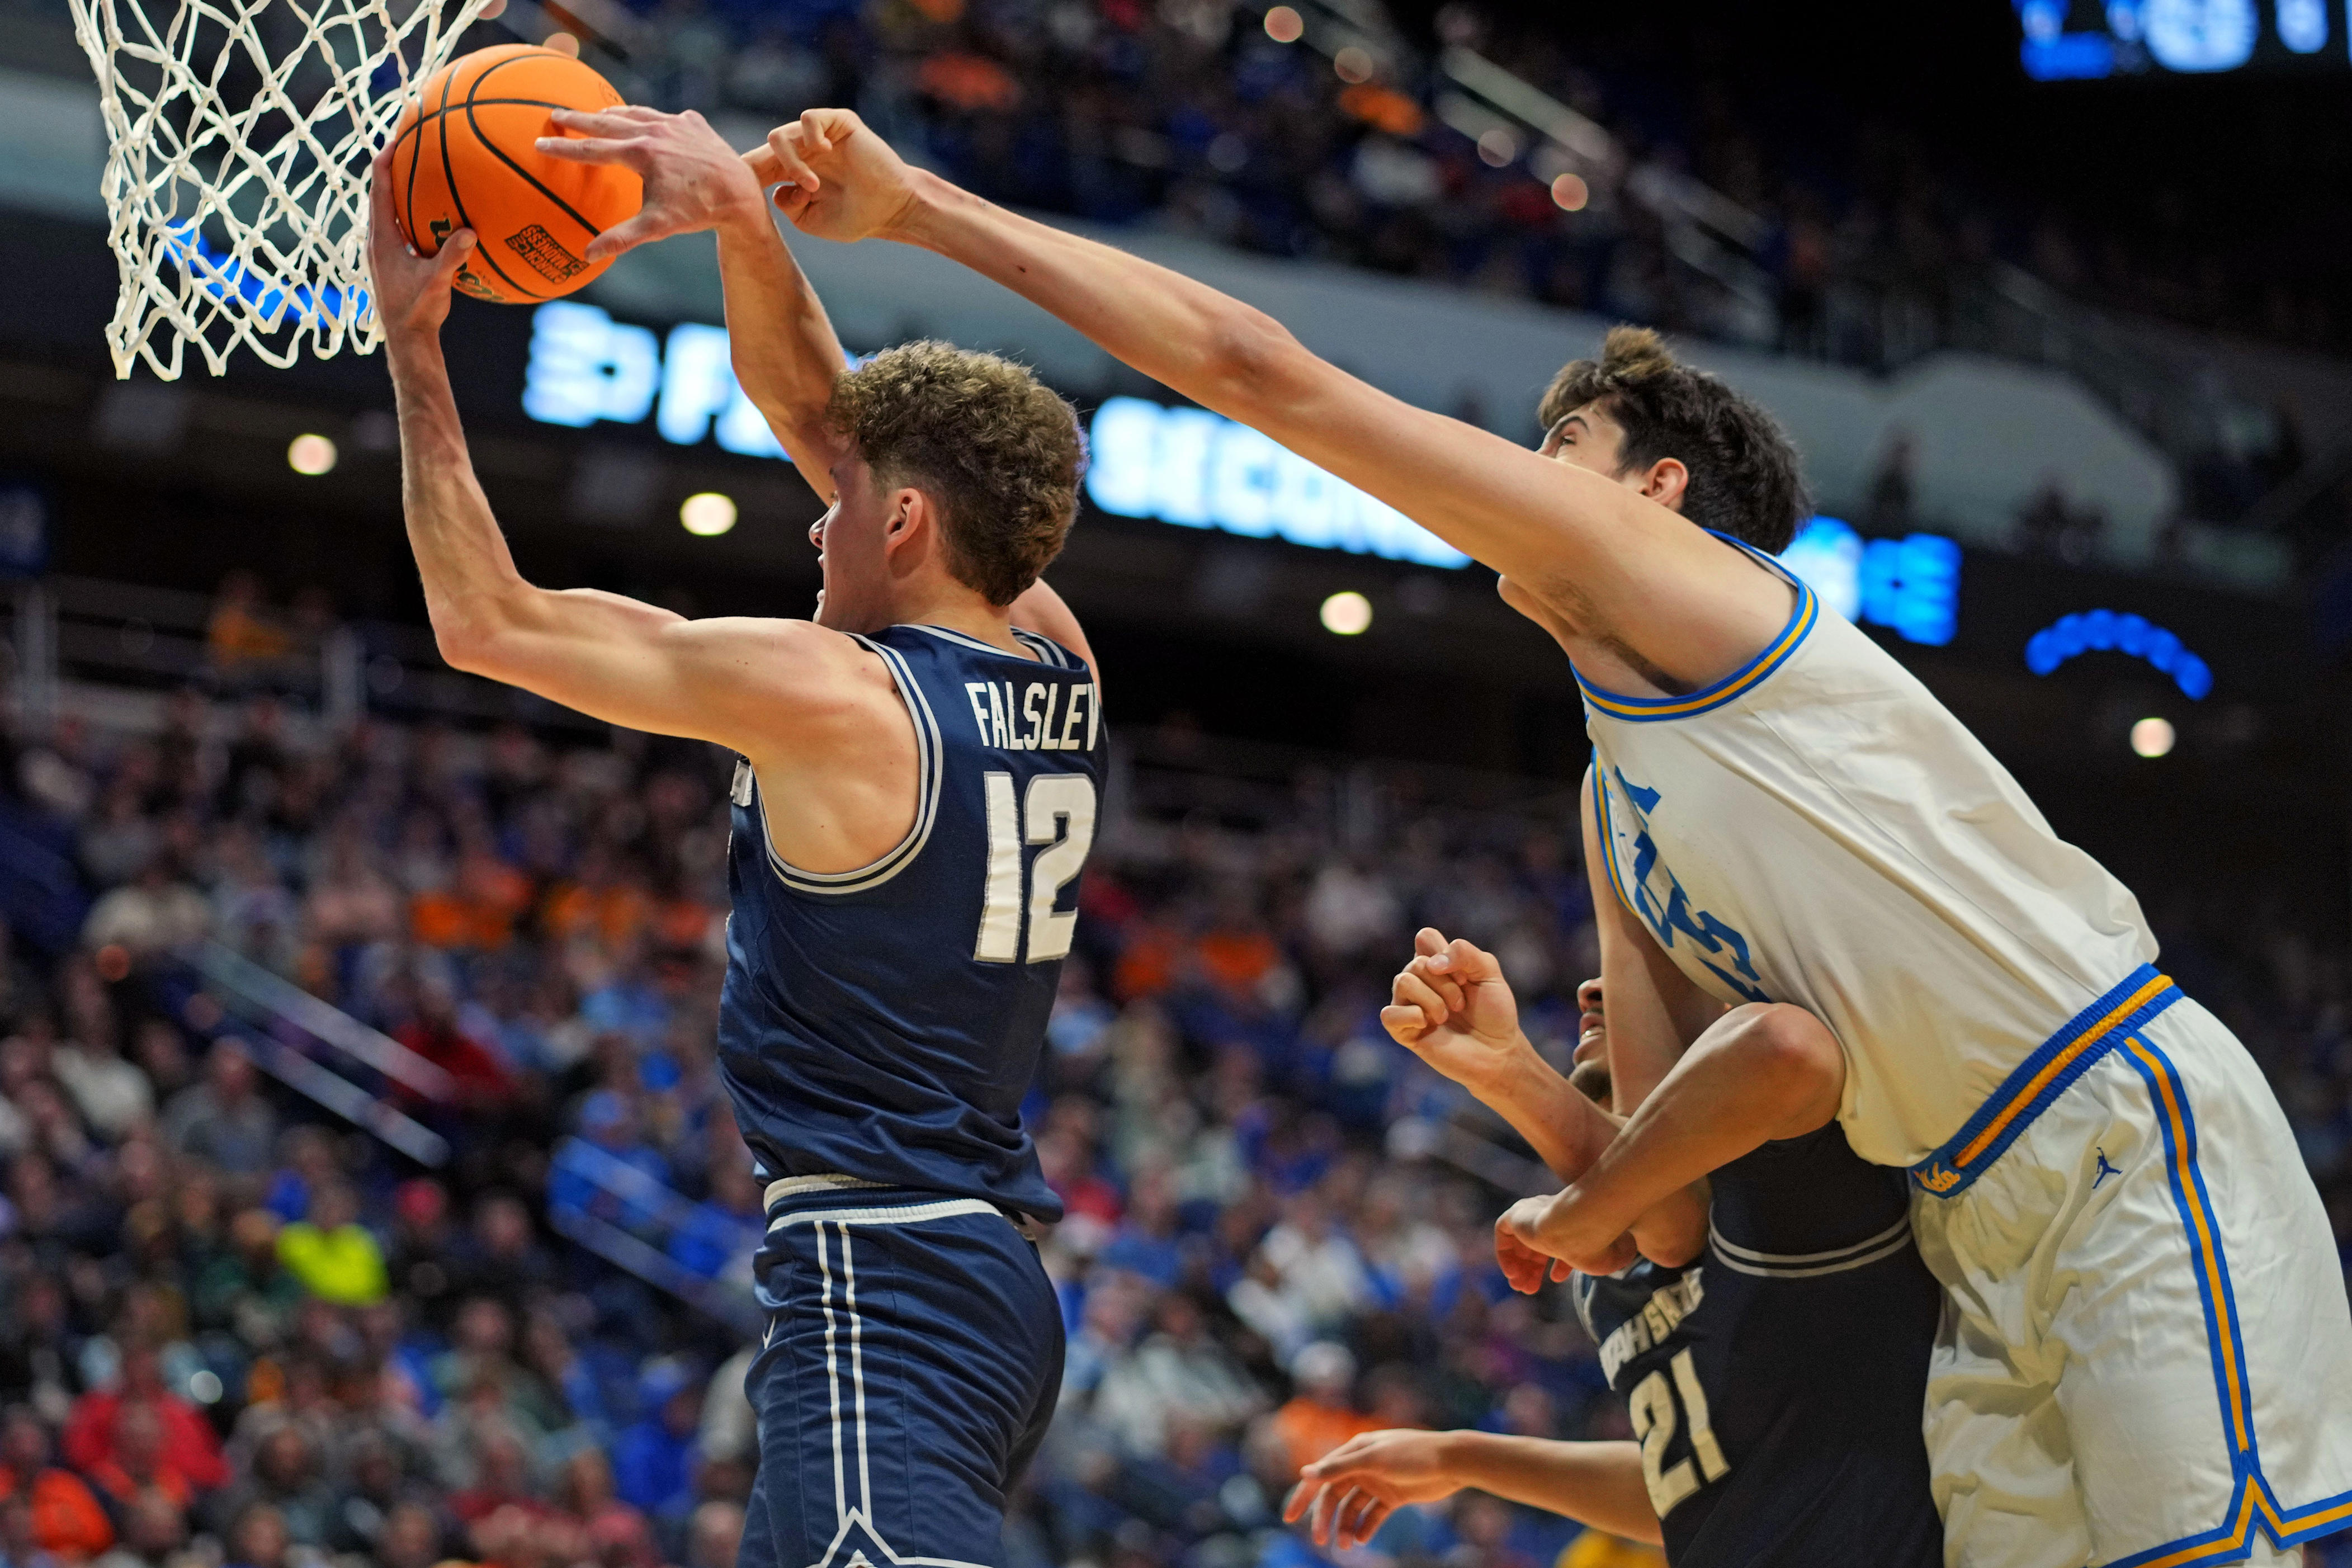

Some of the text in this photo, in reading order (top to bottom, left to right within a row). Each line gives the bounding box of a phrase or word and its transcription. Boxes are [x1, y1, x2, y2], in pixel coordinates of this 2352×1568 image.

[964, 681, 1099, 752] FALSLEV
[974, 771, 1097, 964] 12
[1629, 1346, 1732, 1520] 21
